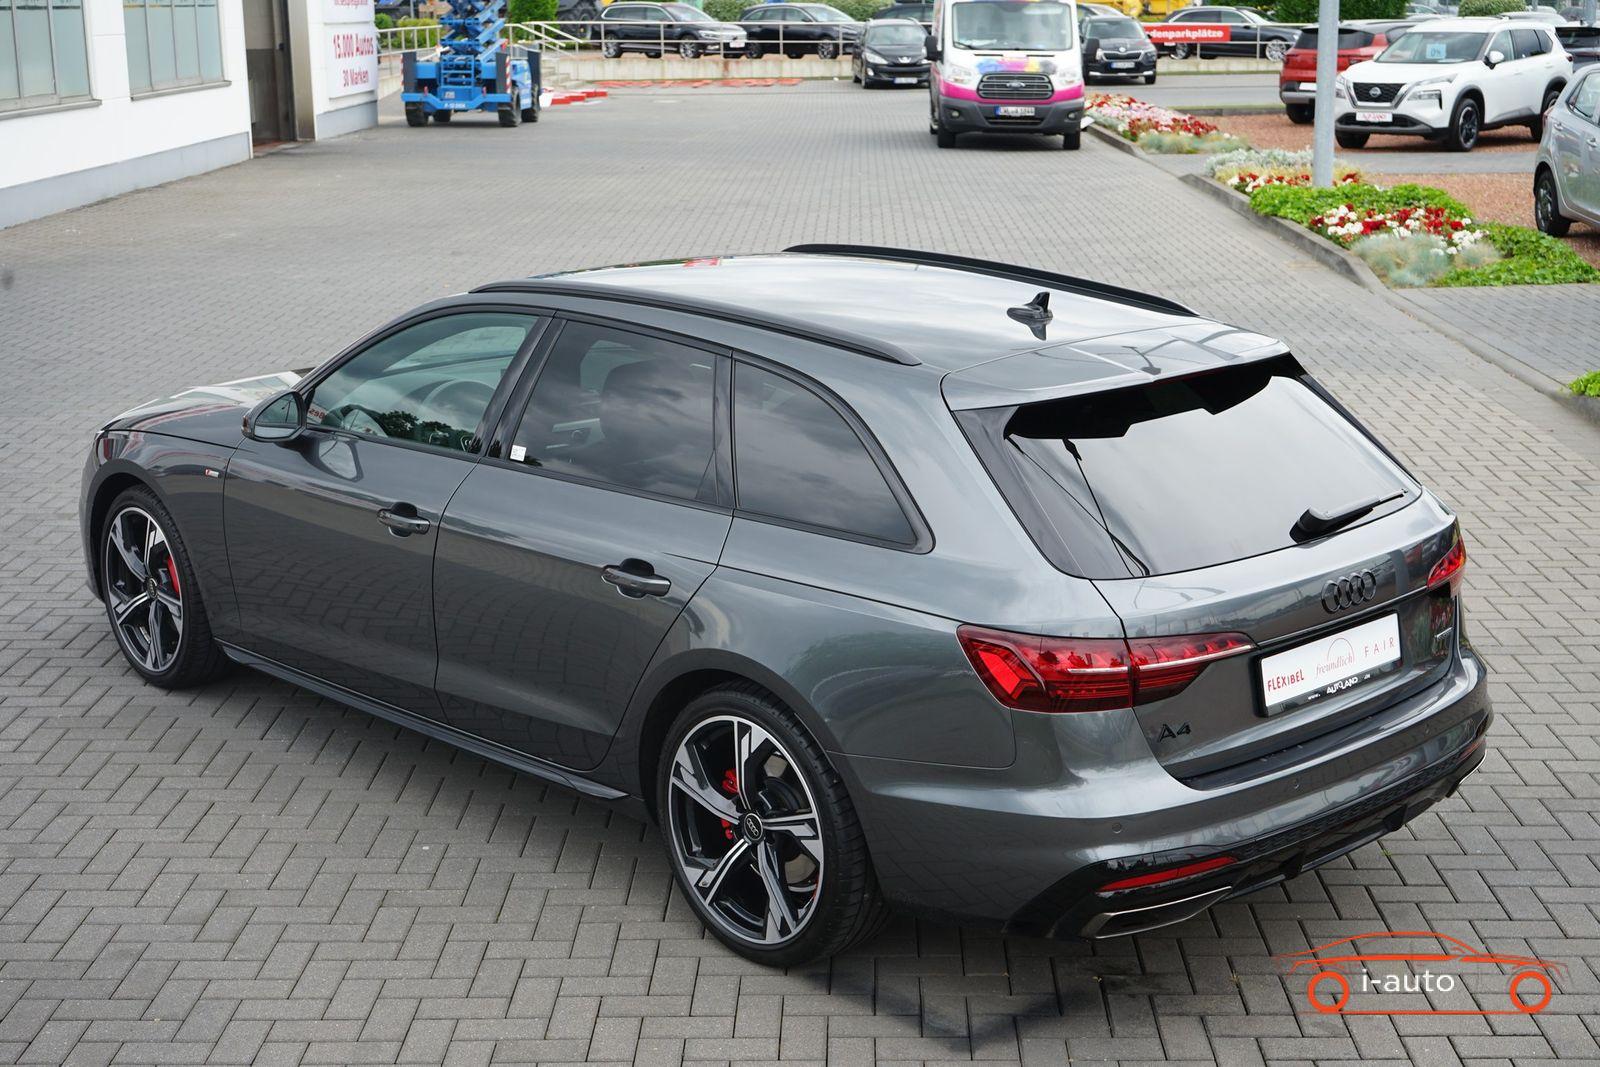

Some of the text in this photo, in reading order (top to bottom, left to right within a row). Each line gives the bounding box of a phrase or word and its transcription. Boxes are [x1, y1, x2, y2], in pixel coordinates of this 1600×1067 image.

[1146, 28, 1224, 40] denparkplätze
[333, 32, 374, 59] 15.000 Autos
[349, 67, 369, 86] Marken
[1268, 637, 1395, 692] FLEXIBEL freundlich FAIR
[1158, 721, 1191, 742] A4
